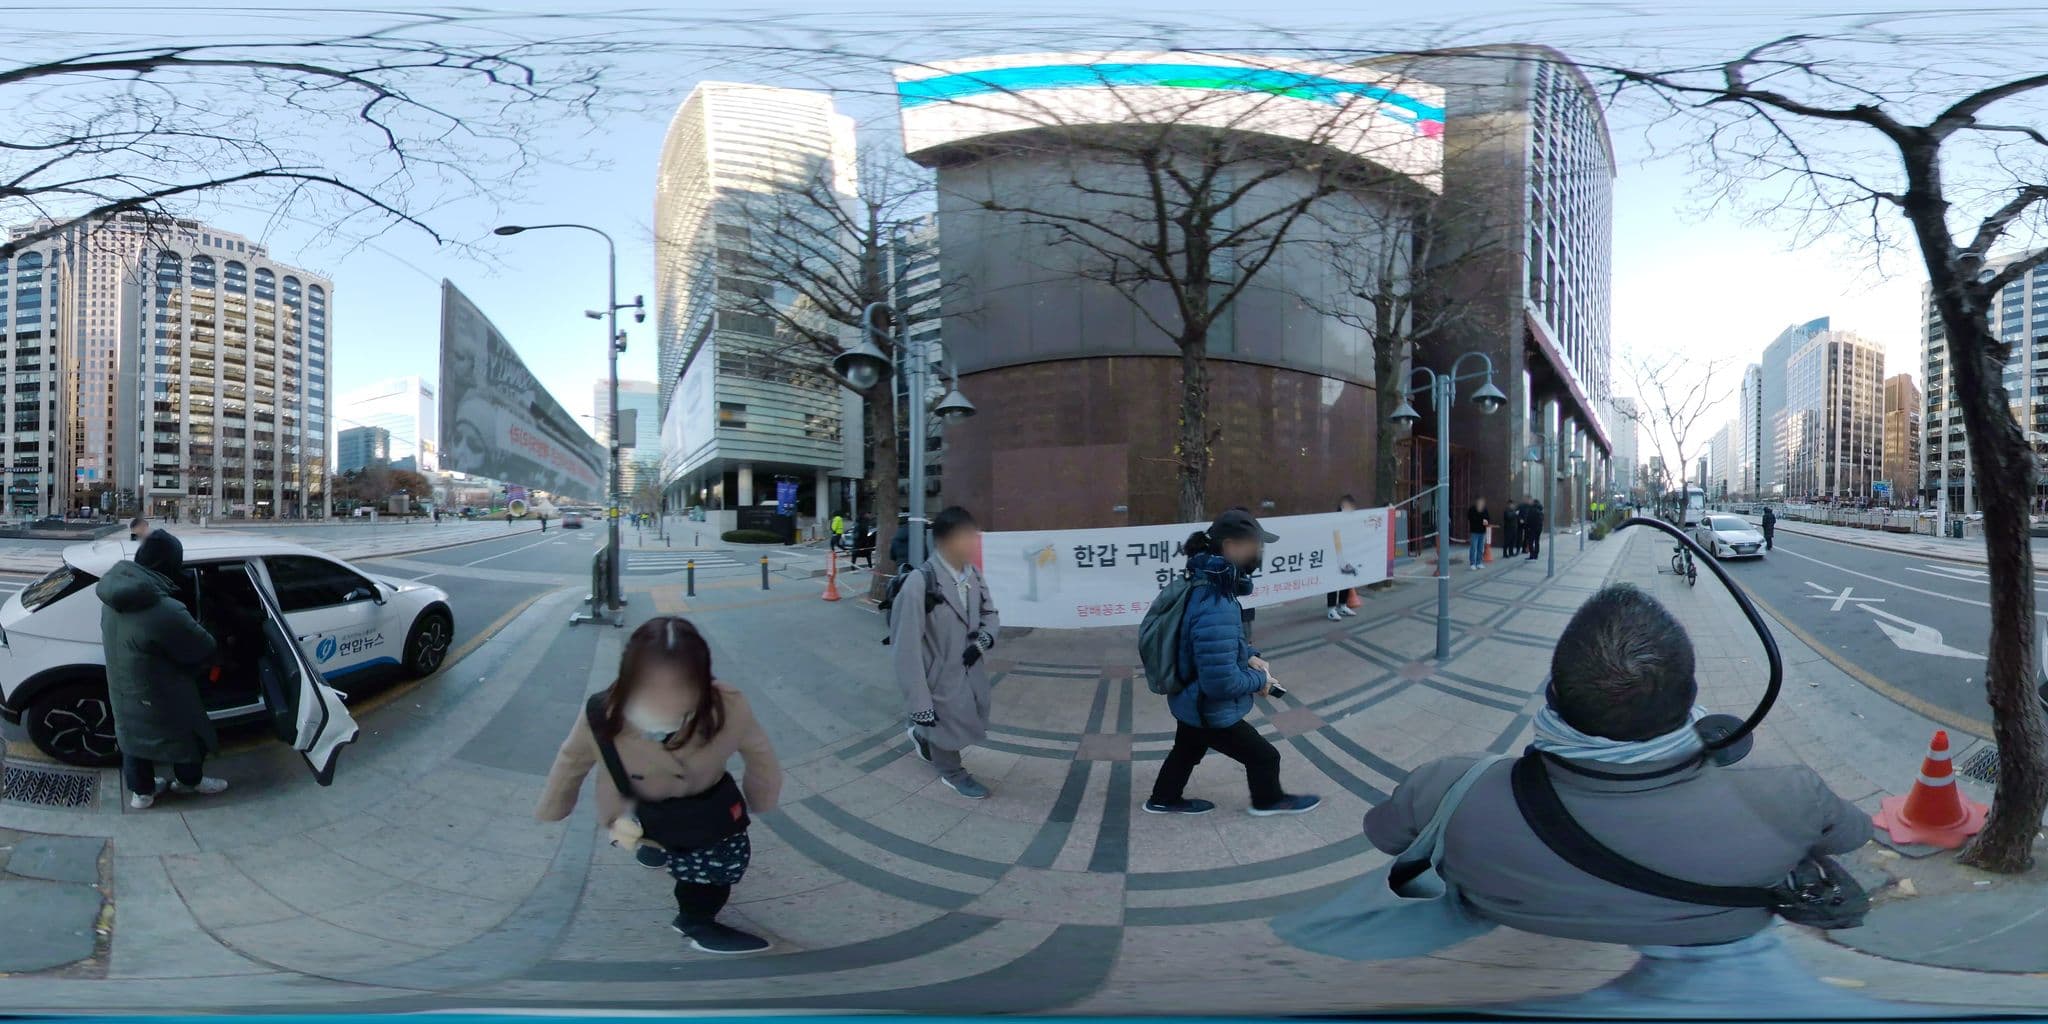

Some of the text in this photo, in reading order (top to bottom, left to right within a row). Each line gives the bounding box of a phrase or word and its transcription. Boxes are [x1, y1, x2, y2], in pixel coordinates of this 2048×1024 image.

[1074, 544, 1118, 568] 한갑
[1309, 549, 1324, 568] 원
[1077, 603, 1126, 617] 담배꽁초
[340, 631, 384, 656] 연합뉴스
